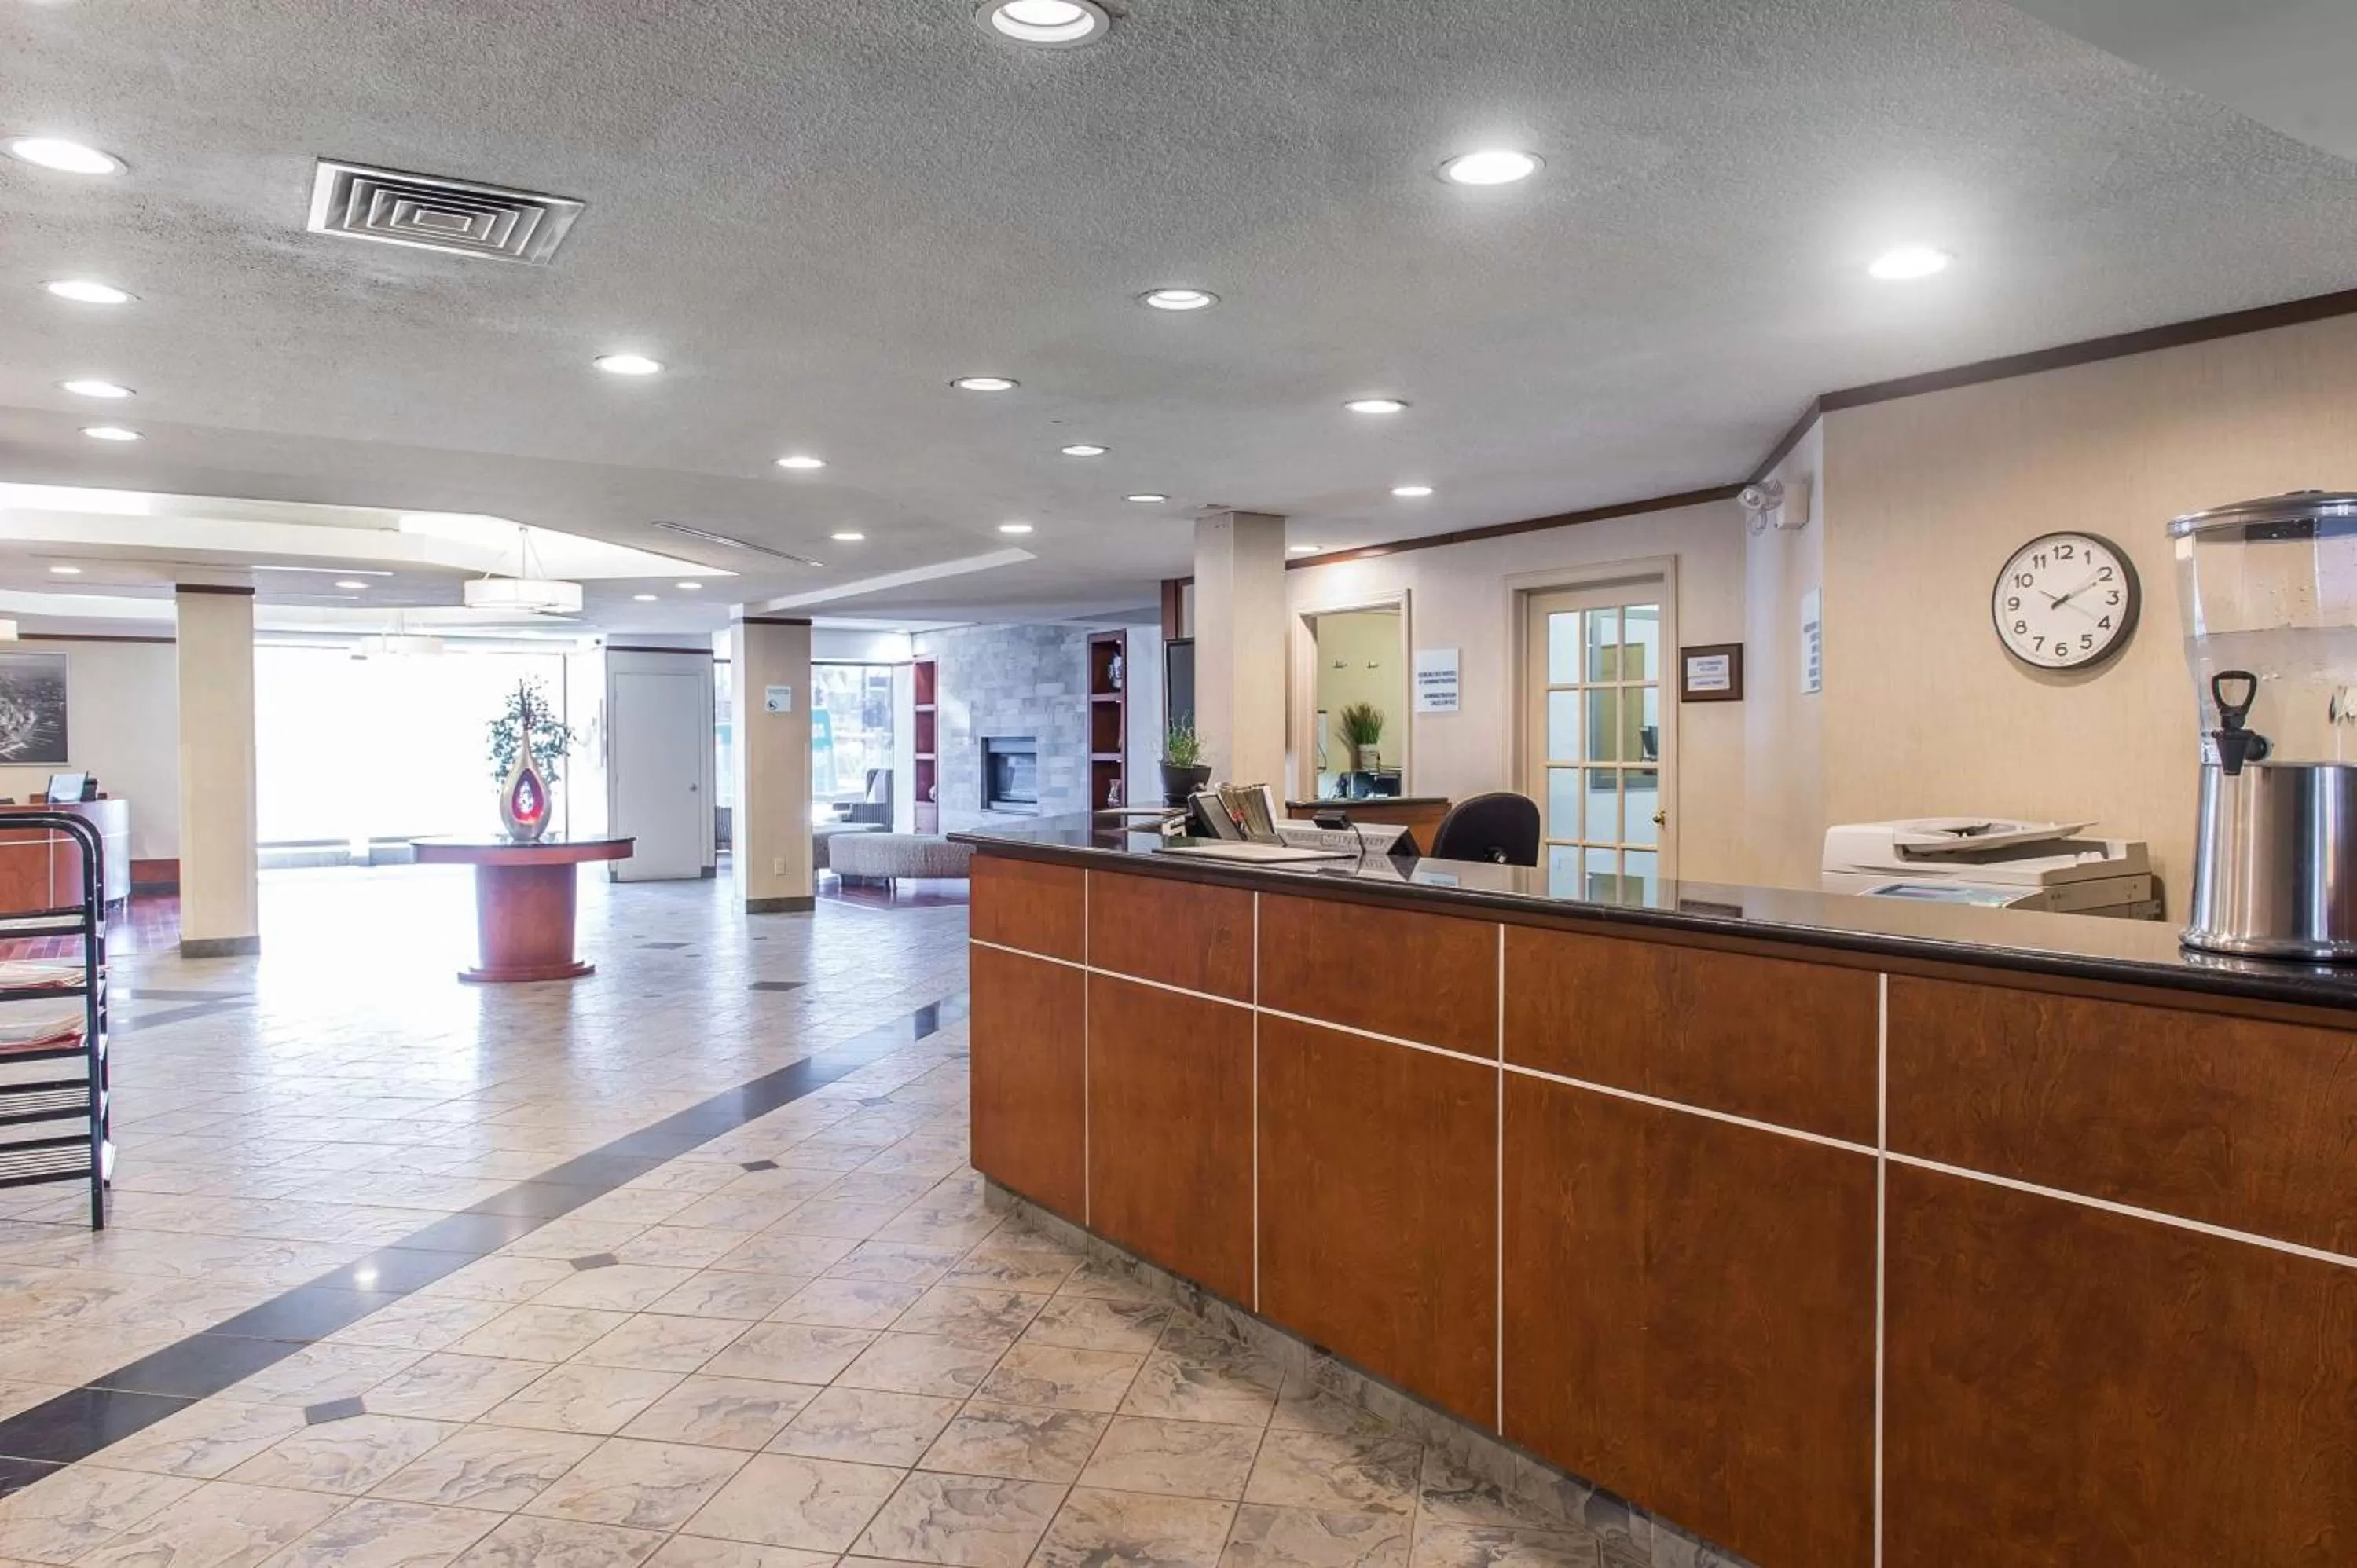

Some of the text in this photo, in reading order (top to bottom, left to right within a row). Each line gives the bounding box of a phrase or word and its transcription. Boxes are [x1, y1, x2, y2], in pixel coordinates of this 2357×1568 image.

[2053, 544, 2073, 559] 12
[2084, 550, 2091, 564] 1
[2032, 555, 2047, 569] 11
[2014, 573, 2034, 588] 10
[2098, 566, 2113, 581] 2
[2008, 597, 2020, 610] 9
[2106, 590, 2119, 605] 3
[2014, 620, 2027, 634] 8
[2097, 616, 2111, 630] 4
[2033, 636, 2044, 651] 7
[2080, 634, 2093, 649] 5
[2055, 643, 2068, 656] 6
